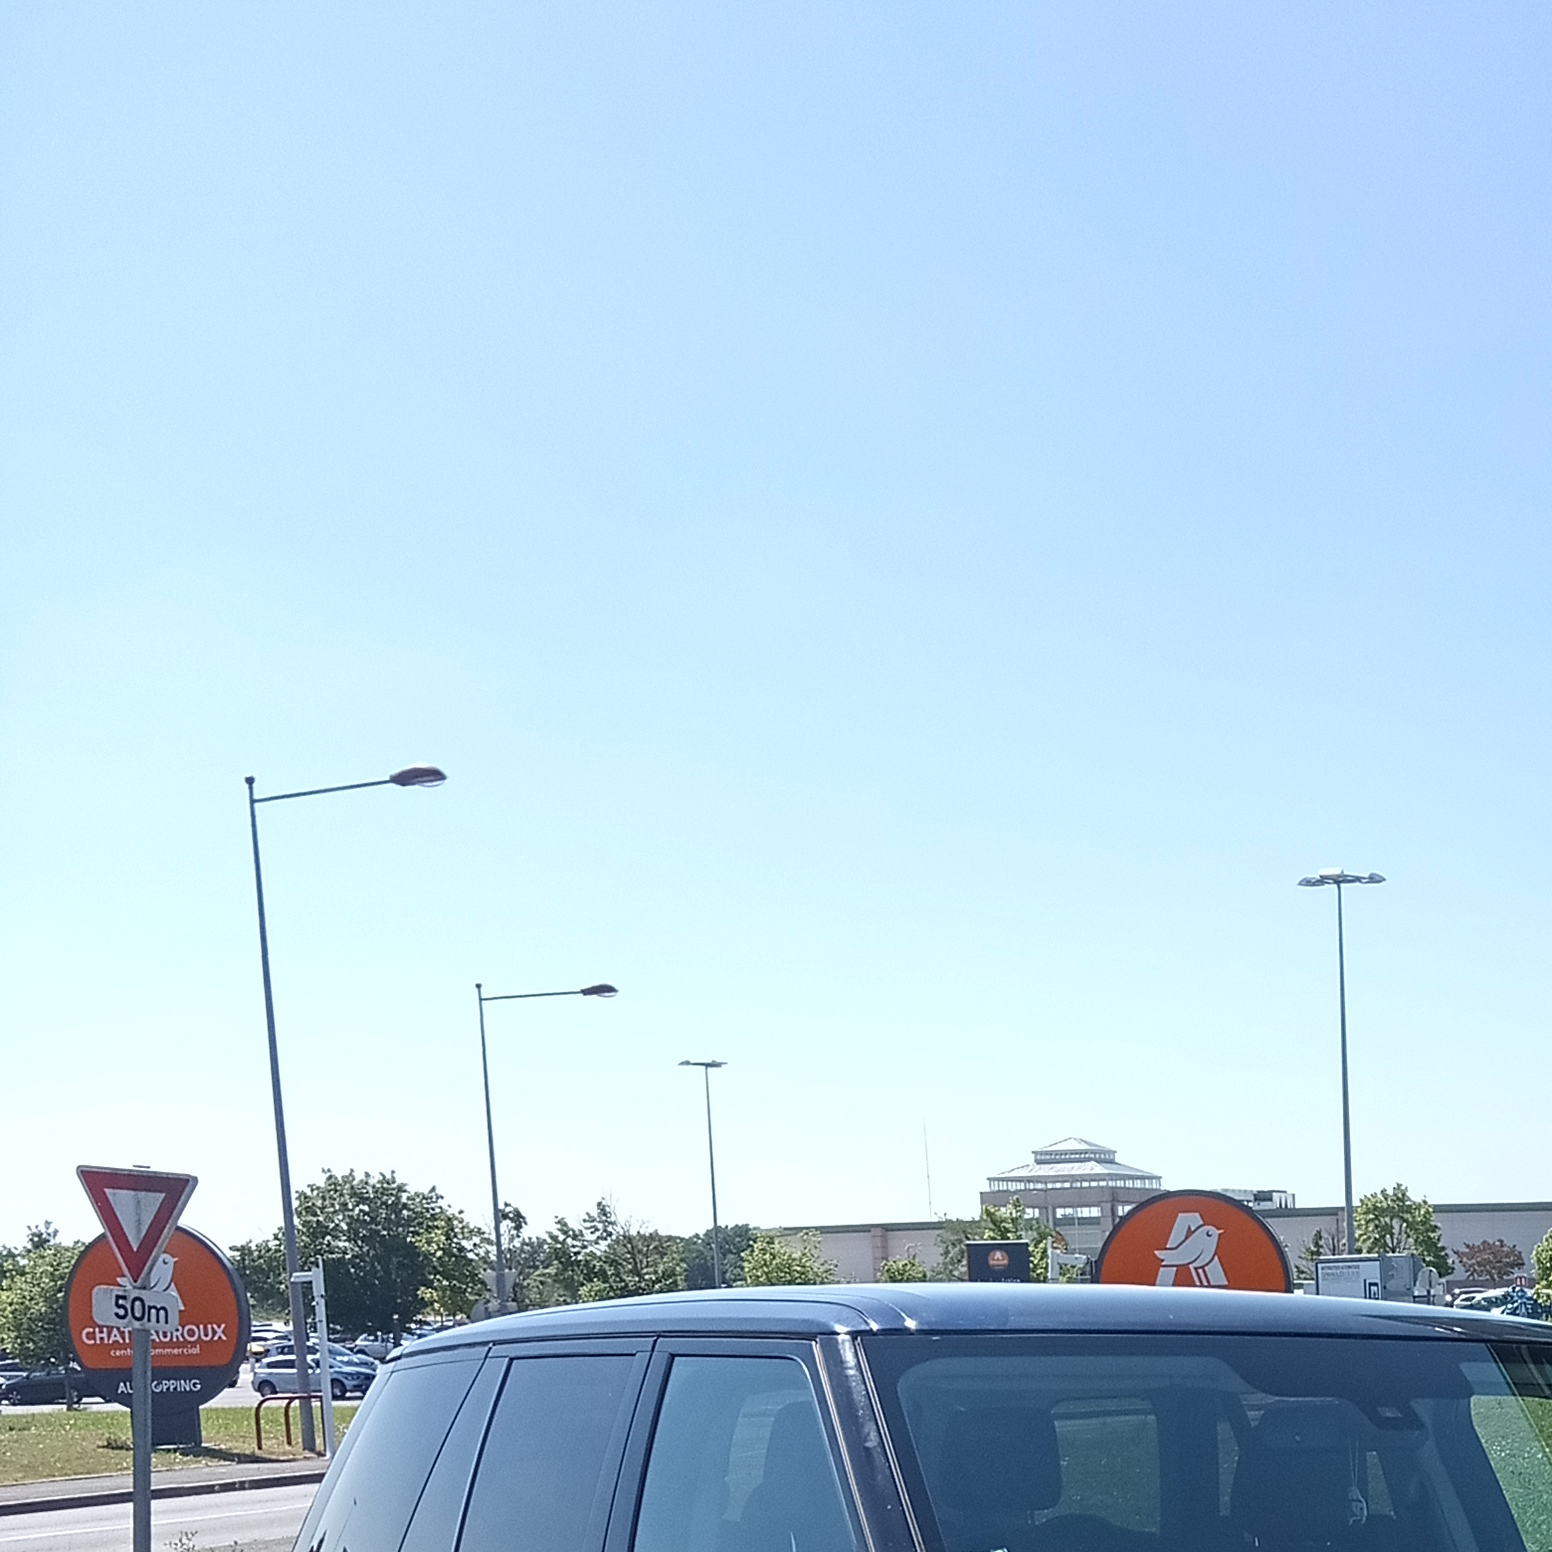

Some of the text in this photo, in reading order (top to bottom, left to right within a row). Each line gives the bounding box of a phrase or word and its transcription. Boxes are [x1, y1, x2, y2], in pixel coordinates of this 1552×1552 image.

[113, 1294, 169, 1325] 50m
[82, 1323, 227, 1345] CHATAUROUX
[117, 1379, 202, 1394] AUOPPING
